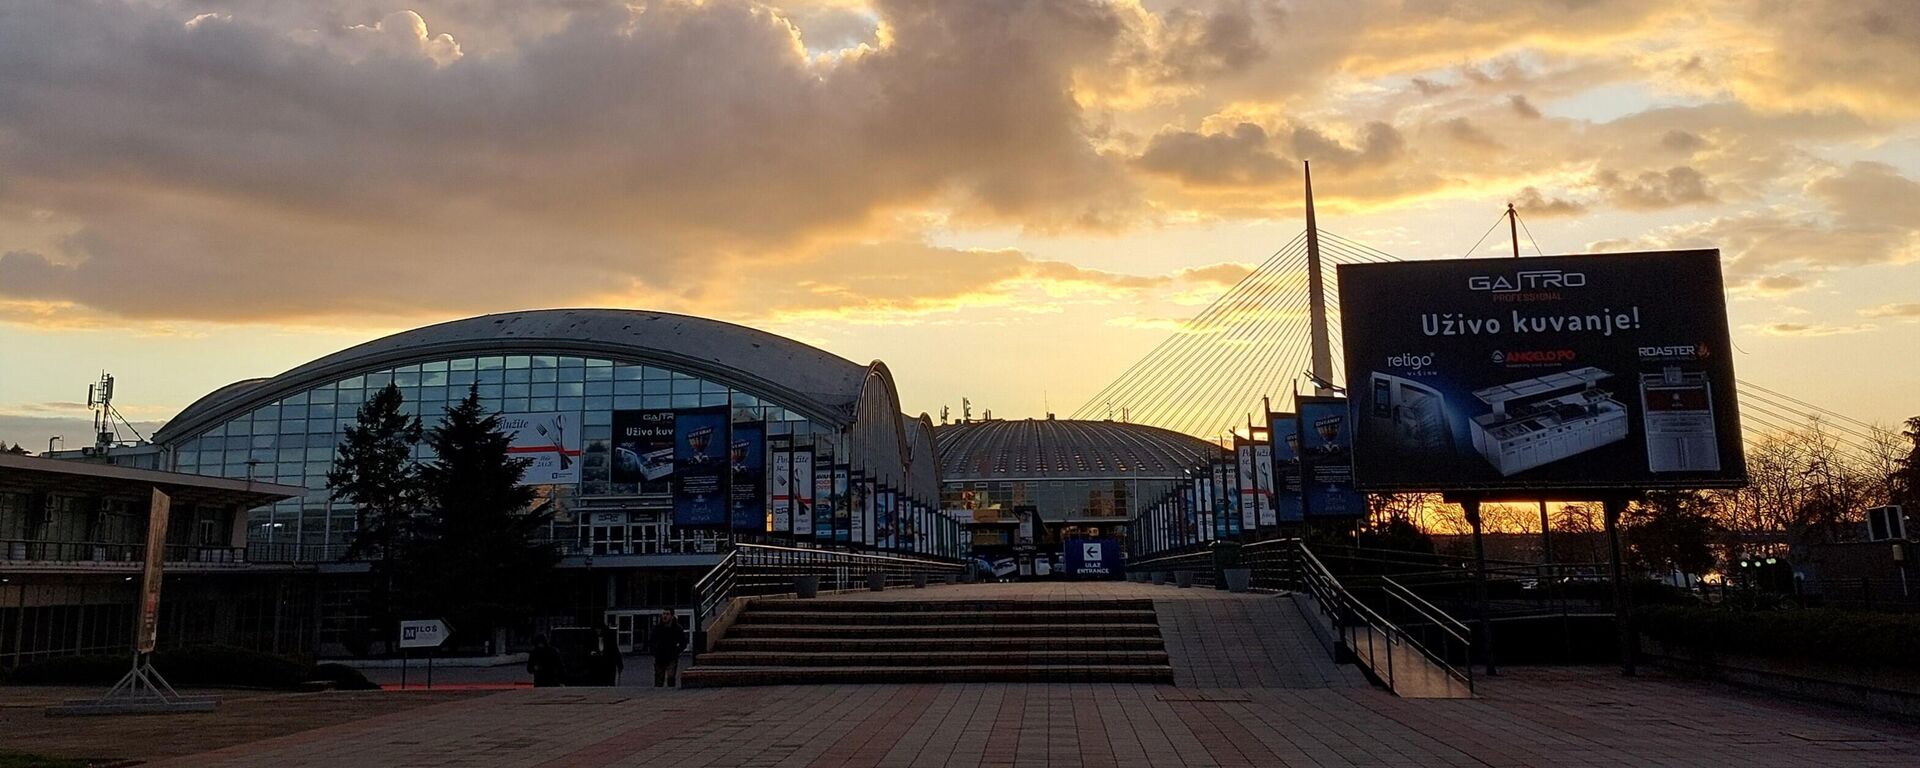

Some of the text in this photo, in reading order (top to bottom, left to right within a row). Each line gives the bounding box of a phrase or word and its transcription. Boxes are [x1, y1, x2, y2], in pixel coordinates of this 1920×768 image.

[1469, 270, 1586, 293] GASTRO
[1493, 292, 1561, 302] PROFESSIONAL
[1421, 306, 1641, 336] Uživo kuvanje!
[1638, 345, 1695, 356] ROASTER
[1387, 352, 1433, 370] retigo
[643, 412, 674, 421] GASTR
[626, 426, 674, 436] Uživo kuv
